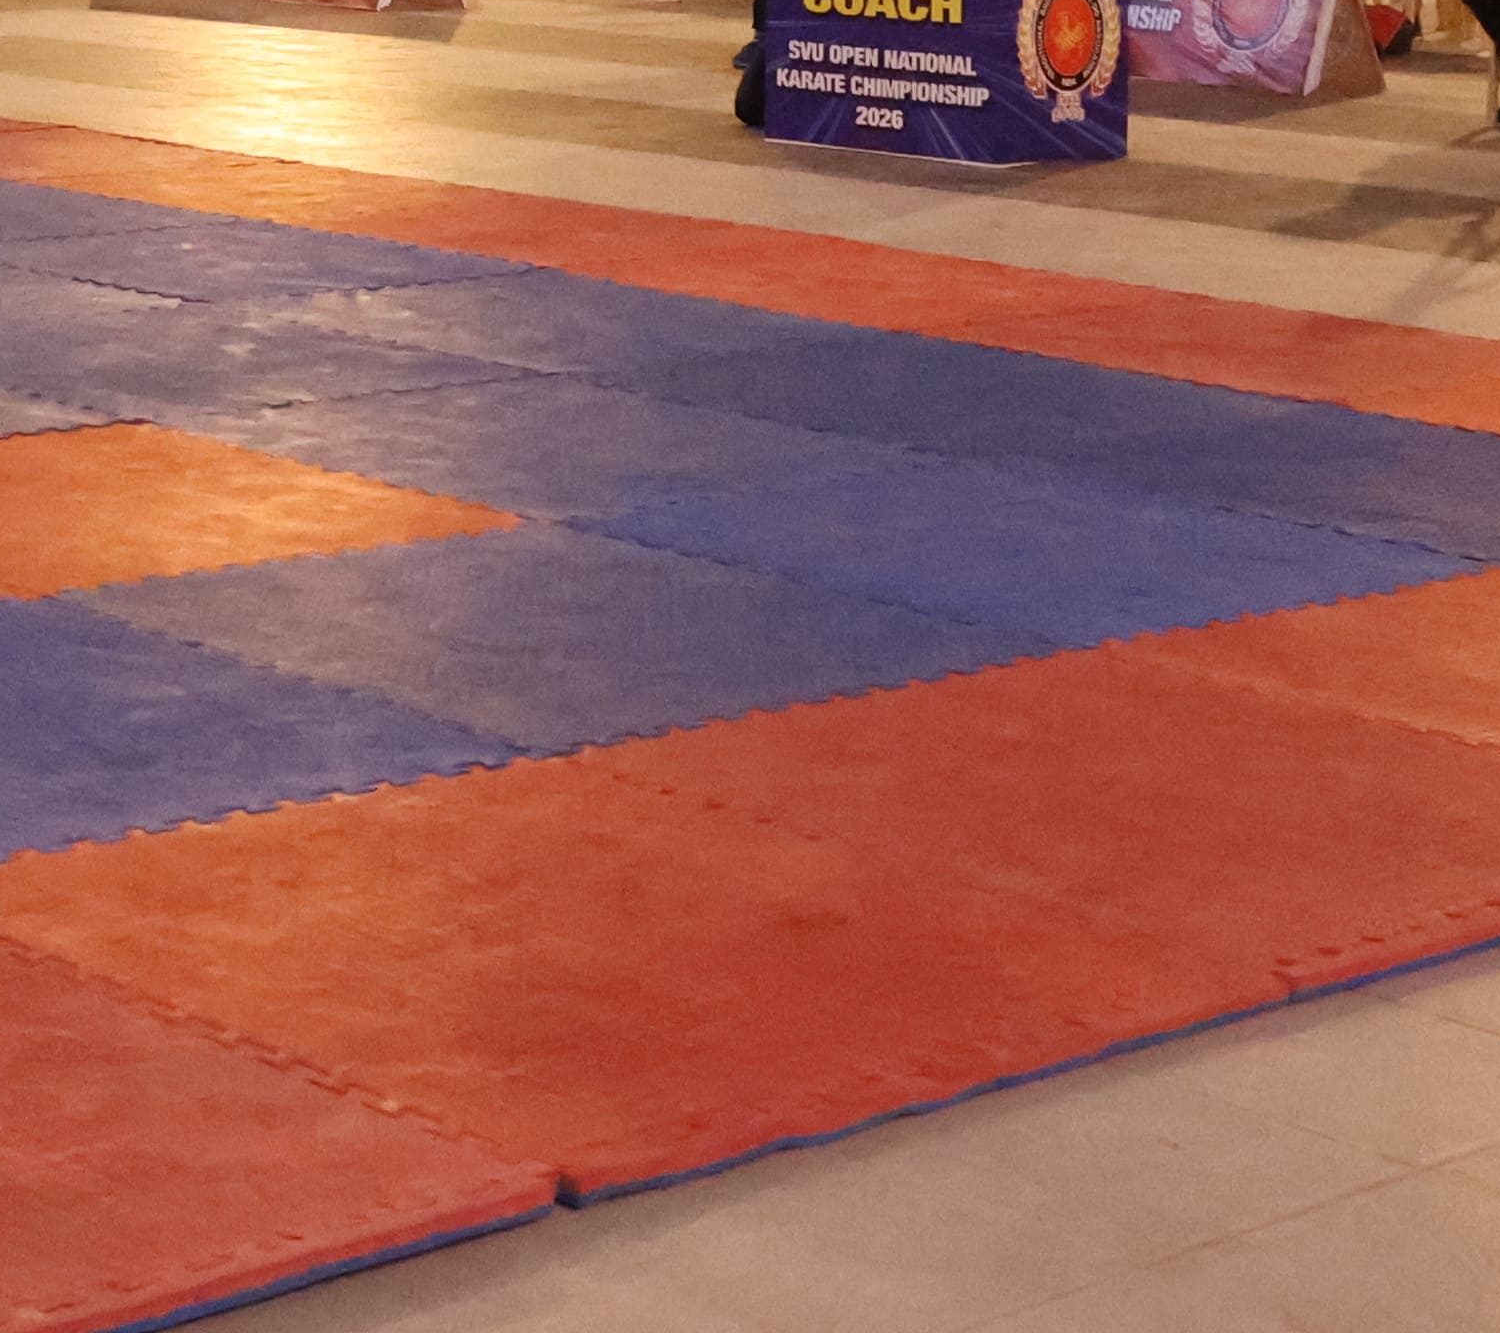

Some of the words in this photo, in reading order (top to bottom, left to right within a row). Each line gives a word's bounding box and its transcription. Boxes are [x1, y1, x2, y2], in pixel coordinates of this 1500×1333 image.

[788, 39, 824, 62] SVU
[829, 45, 879, 68] OPEN
[884, 49, 977, 77] NATIONAL
[776, 68, 847, 94] KARATE
[851, 75, 990, 108] CHIMPIONSHIP
[855, 106, 904, 130] 2026
